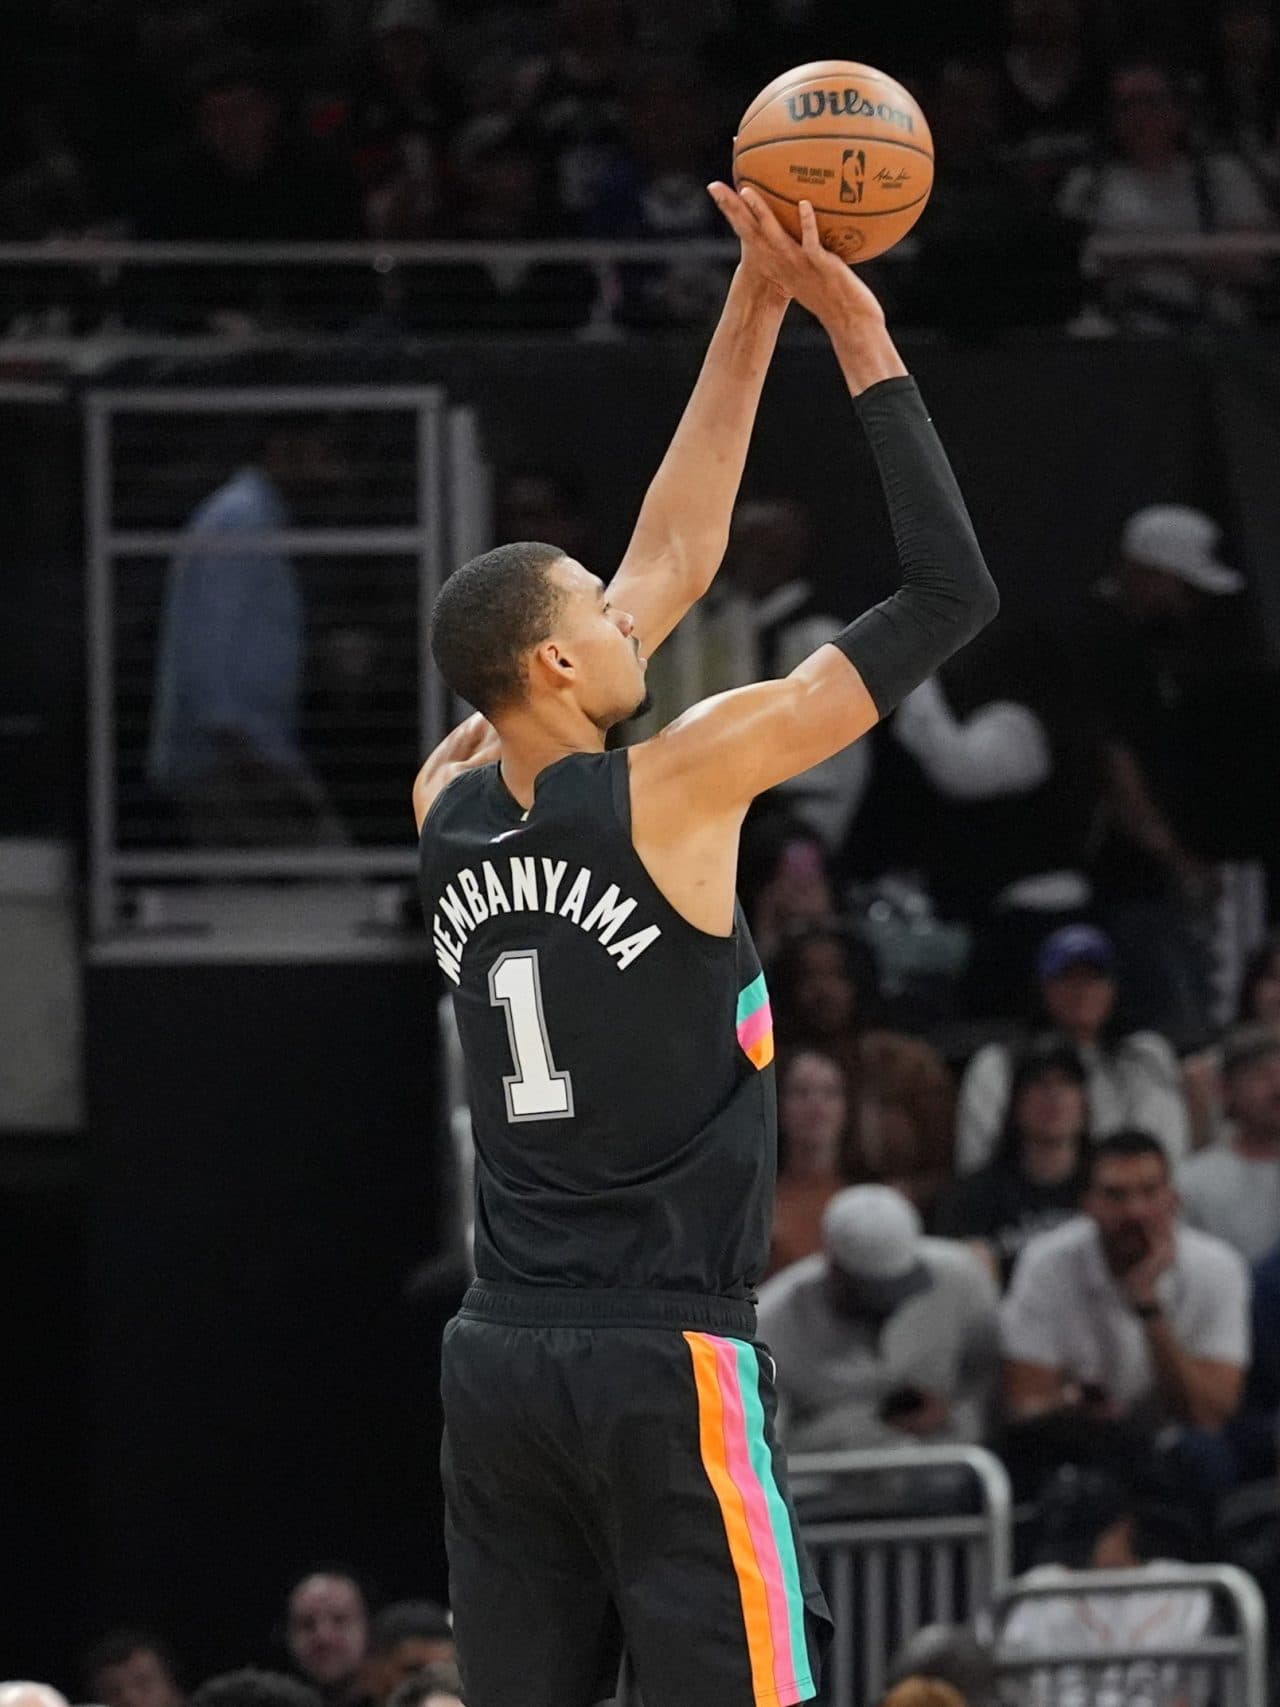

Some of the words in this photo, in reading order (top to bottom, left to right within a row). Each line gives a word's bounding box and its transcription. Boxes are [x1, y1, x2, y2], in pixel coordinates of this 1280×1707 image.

[785, 88, 914, 135] Wilson
[432, 856, 662, 986] WEMBANYAMA
[487, 948, 575, 1123] 1
